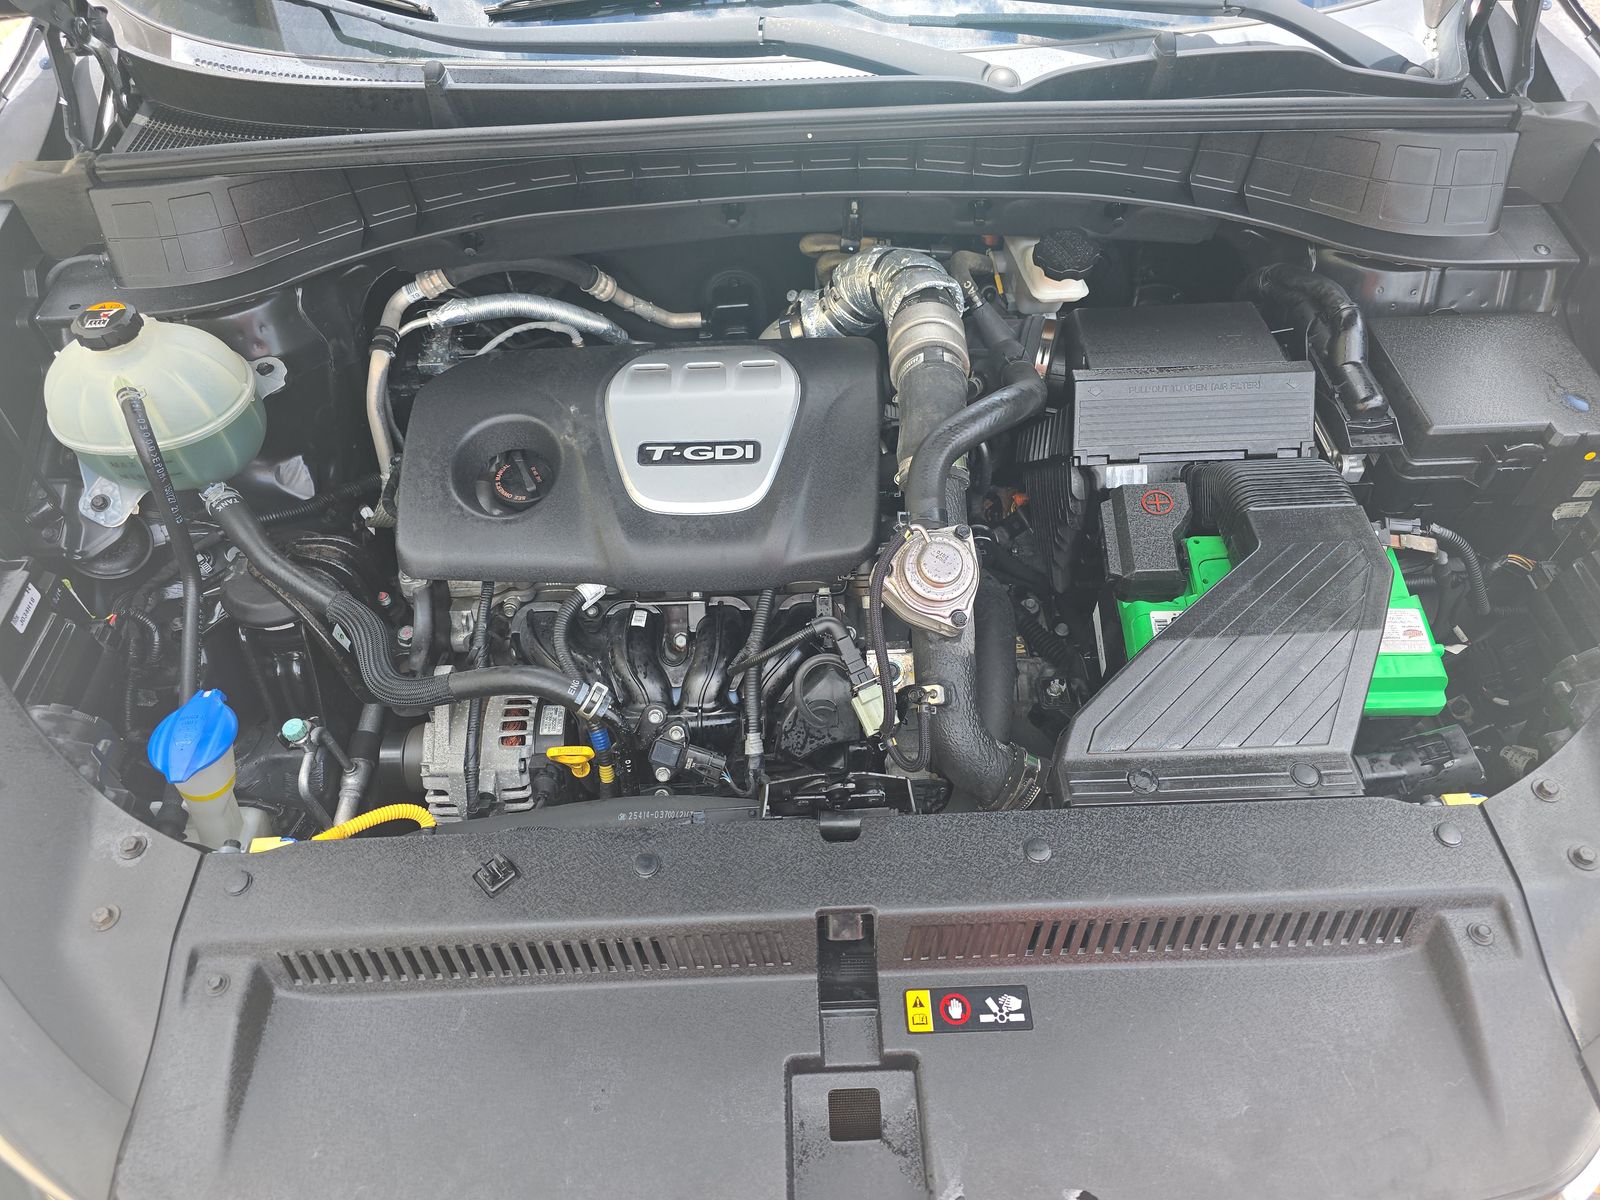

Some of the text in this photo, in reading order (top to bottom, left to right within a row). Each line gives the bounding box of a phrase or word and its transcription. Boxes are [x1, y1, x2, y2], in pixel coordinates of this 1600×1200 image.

[1128, 386, 1151, 394] PULL
[1152, 385, 1169, 393] OUT
[1184, 383, 1208, 391] OPEN
[645, 444, 754, 461] T-GDI
[216, 498, 240, 512] TANK
[567, 679, 580, 696] ENG
